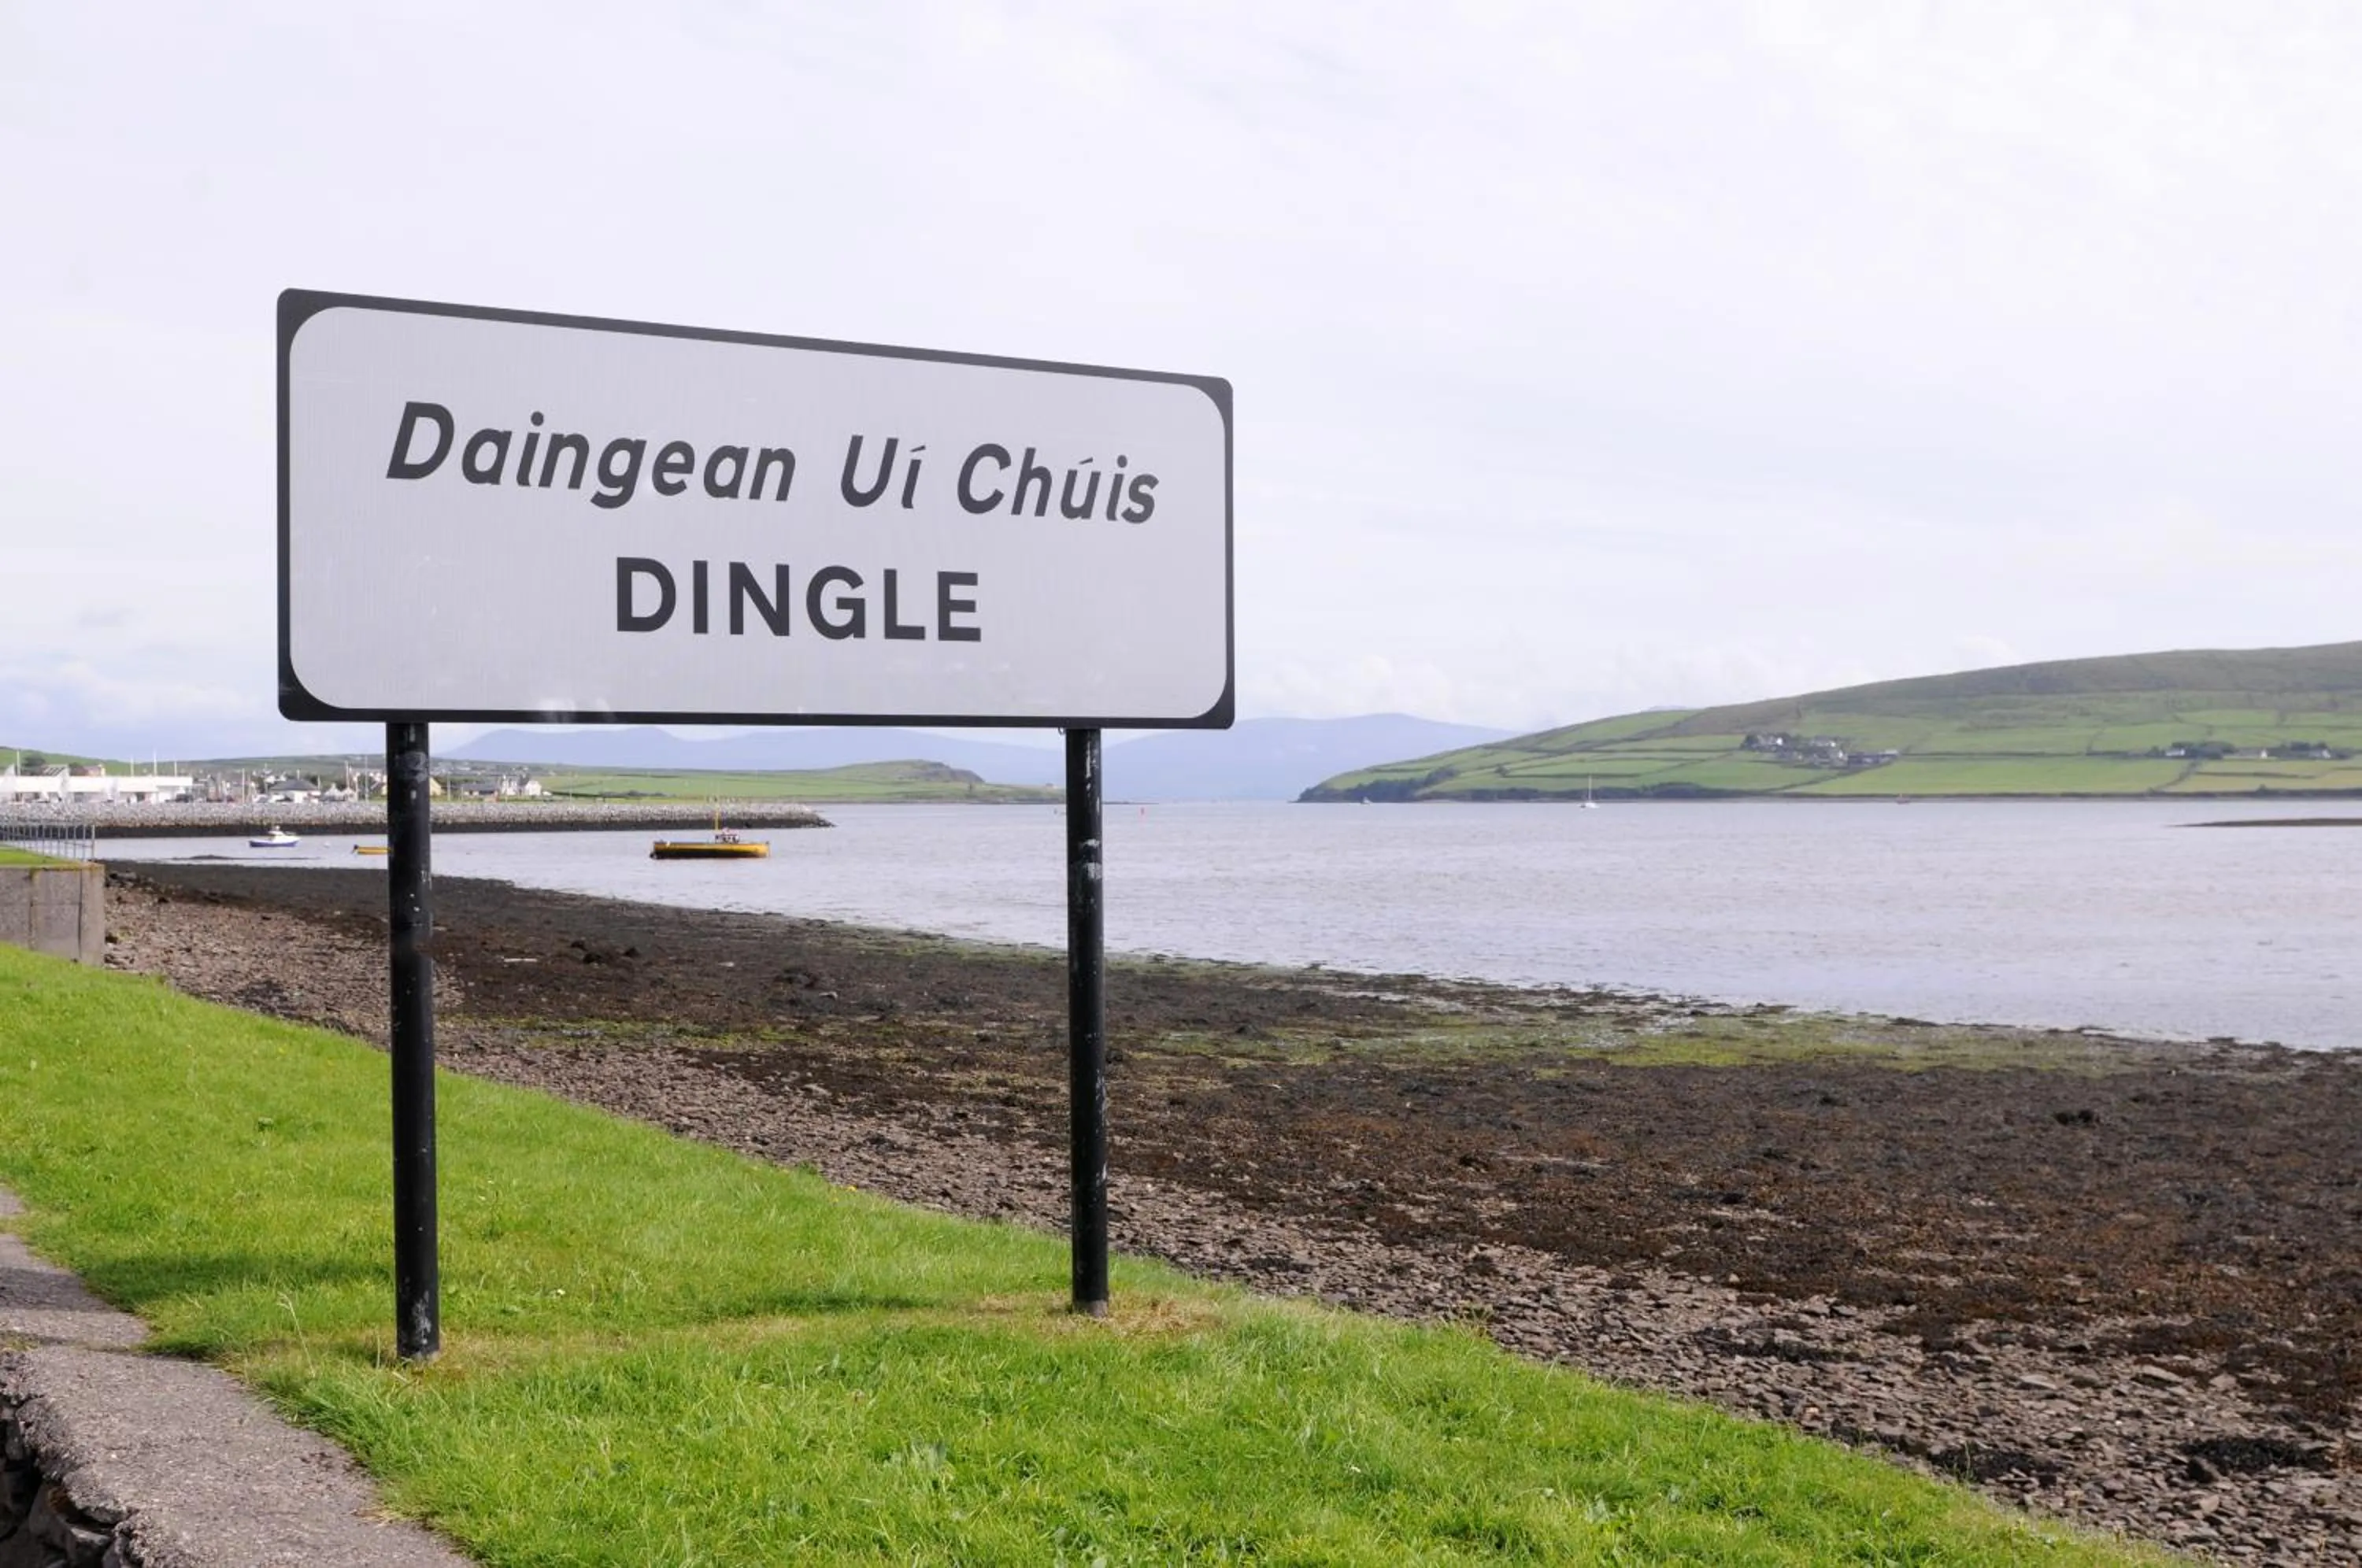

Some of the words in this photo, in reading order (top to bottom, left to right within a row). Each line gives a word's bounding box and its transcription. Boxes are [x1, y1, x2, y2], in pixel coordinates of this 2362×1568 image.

[386, 401, 797, 509] Daingean
[840, 435, 927, 509] Uí
[957, 443, 1160, 523] Chúis
[616, 557, 982, 642] DINGLE
